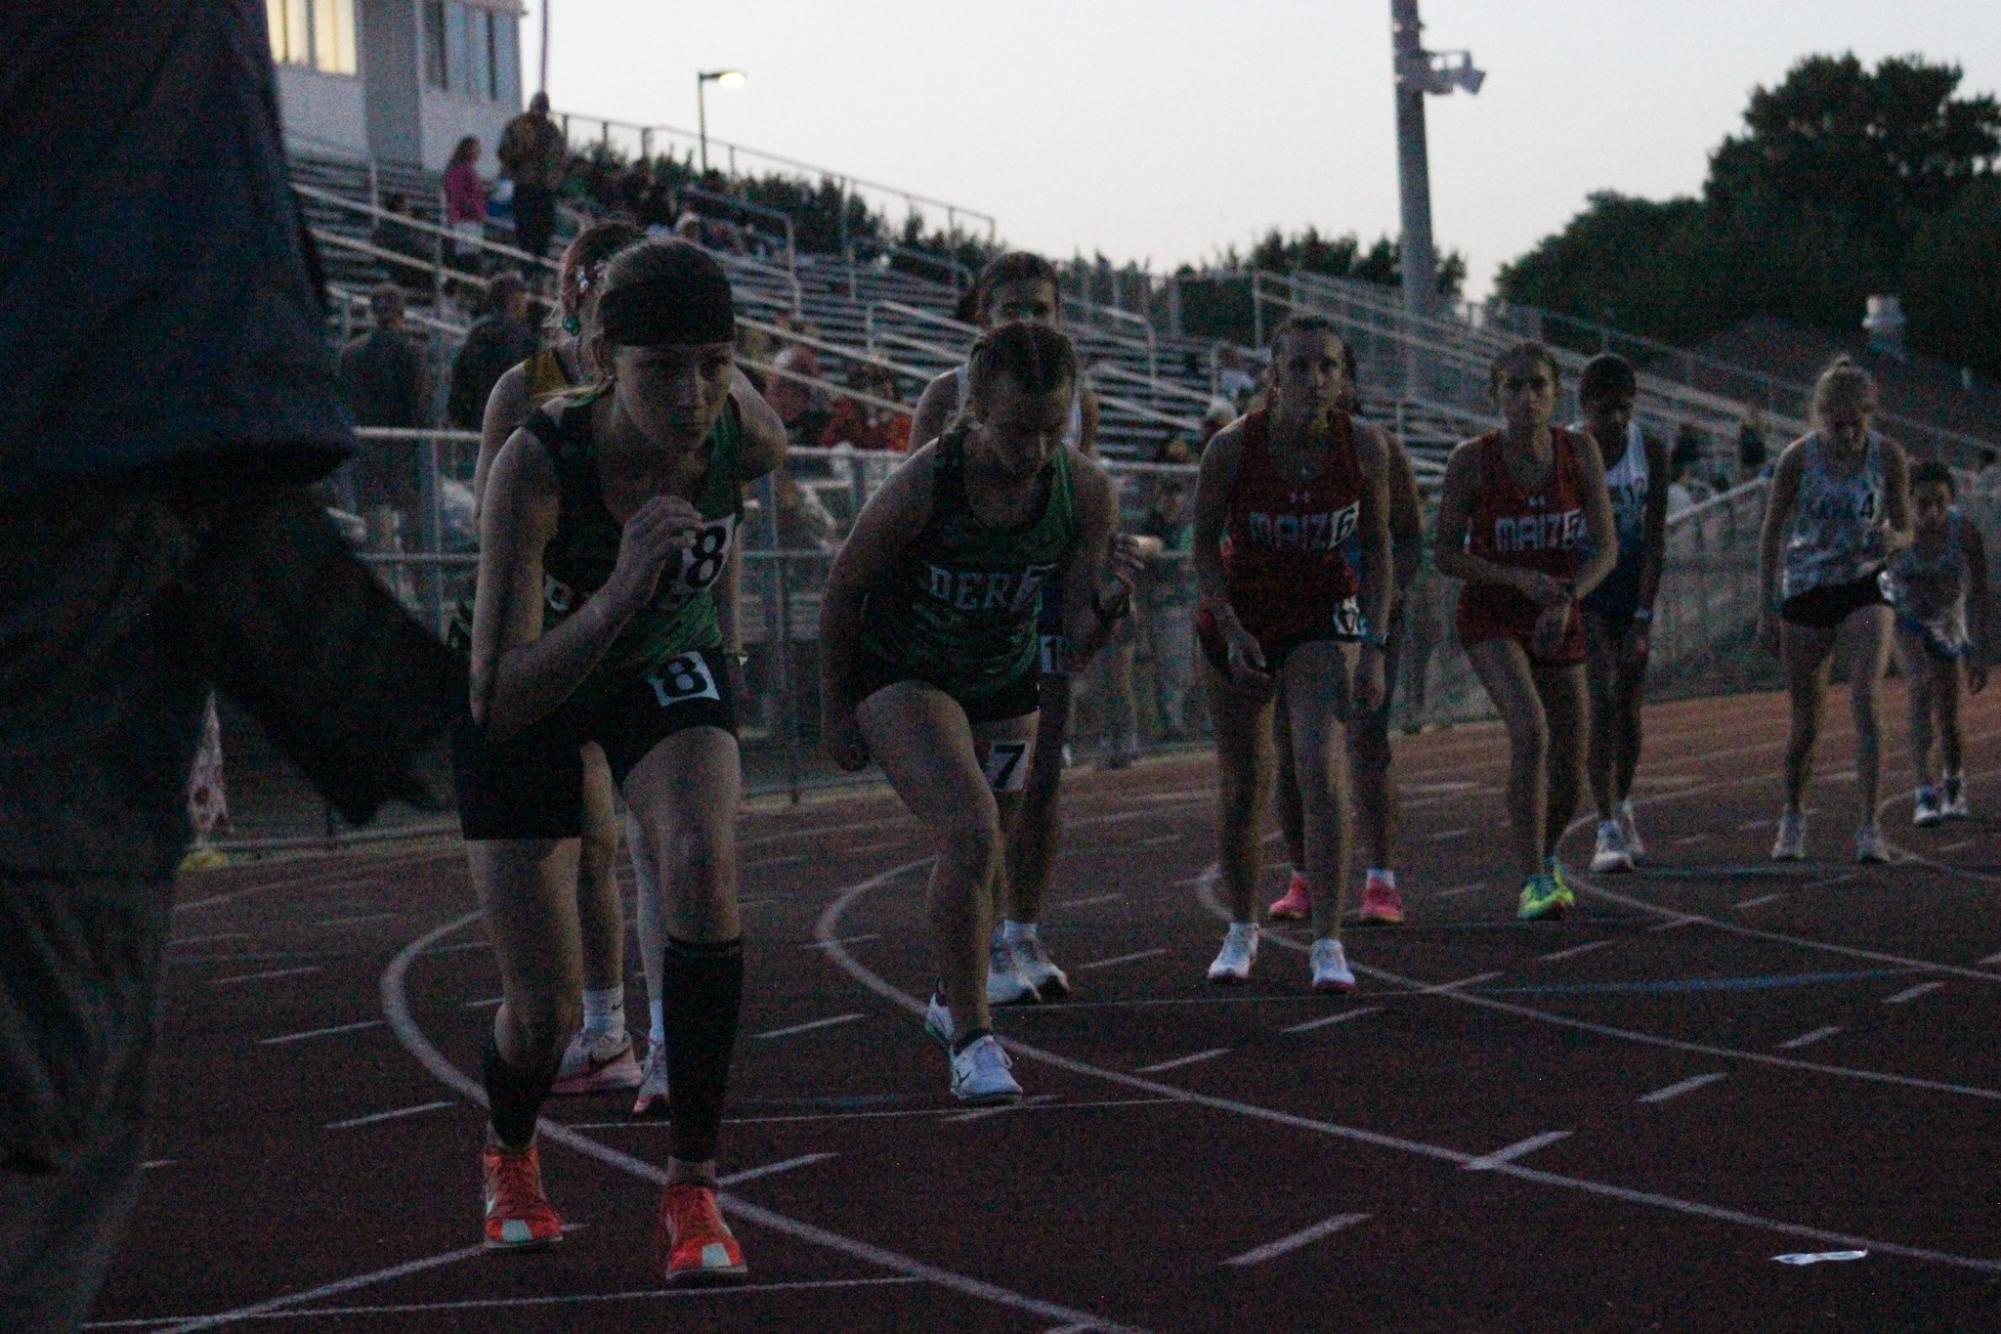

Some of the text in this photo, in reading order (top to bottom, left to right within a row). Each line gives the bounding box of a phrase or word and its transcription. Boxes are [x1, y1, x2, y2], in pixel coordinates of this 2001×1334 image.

[1249, 511, 1328, 552] MAIZ
[685, 524, 727, 589] 8
[662, 655, 708, 697] 8
[994, 742, 1027, 789] 7
